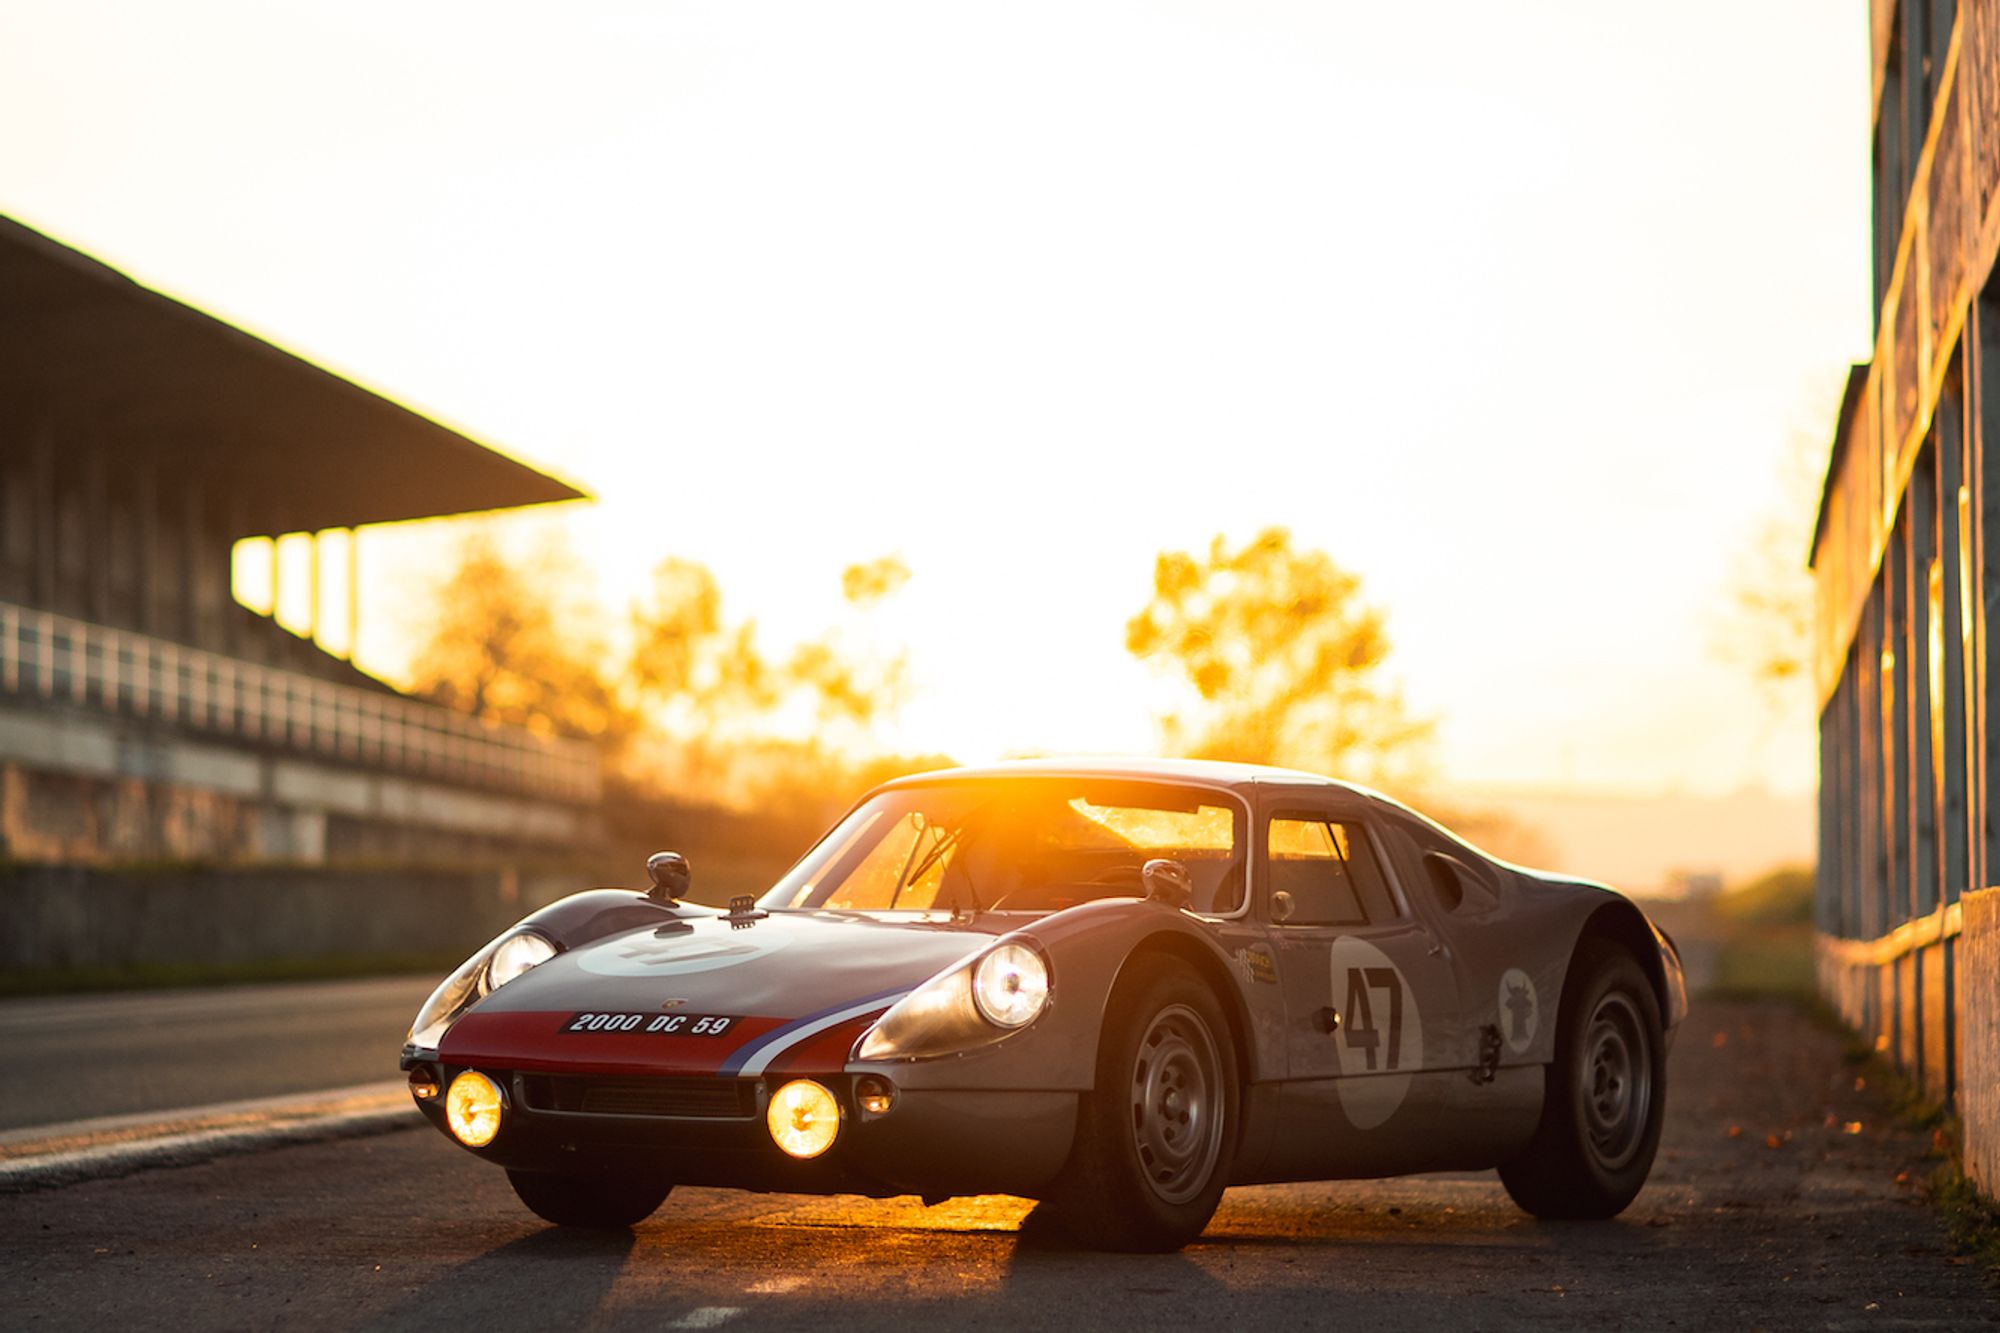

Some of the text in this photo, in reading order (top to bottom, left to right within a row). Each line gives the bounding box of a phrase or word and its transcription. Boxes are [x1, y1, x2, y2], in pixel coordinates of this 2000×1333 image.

[569, 1013, 731, 1034] 2000 DC 59
[1344, 968, 1403, 1070] 47
